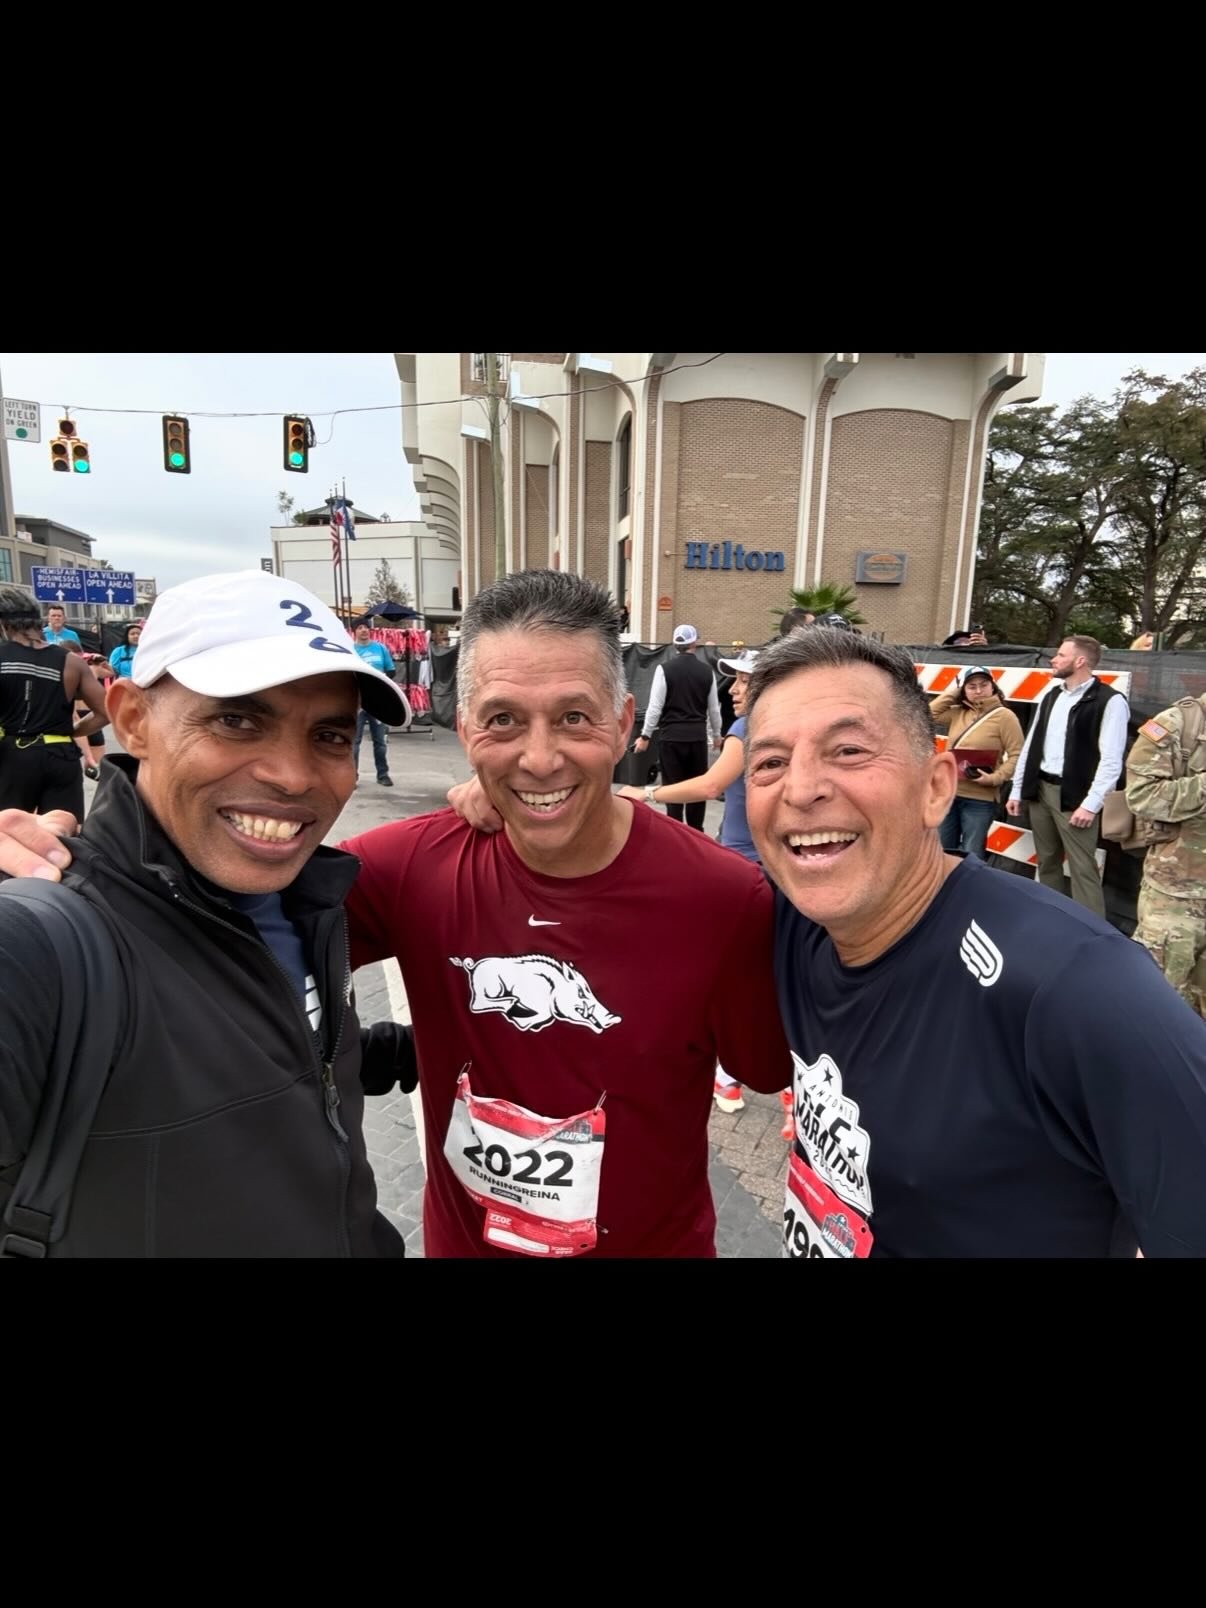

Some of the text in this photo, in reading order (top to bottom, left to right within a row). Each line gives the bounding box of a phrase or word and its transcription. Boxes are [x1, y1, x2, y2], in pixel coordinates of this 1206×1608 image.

[7, 410, 36, 420] YIELD
[684, 540, 785, 571] Hilton
[37, 575, 80, 583] BUSINESSES
[108, 581, 133, 589] AHEAD
[279, 599, 324, 632] 2
[463, 1143, 574, 1187] 2022
[469, 1165, 561, 1201] RUNNINGREINA
[489, 1213, 513, 1225] 2022
